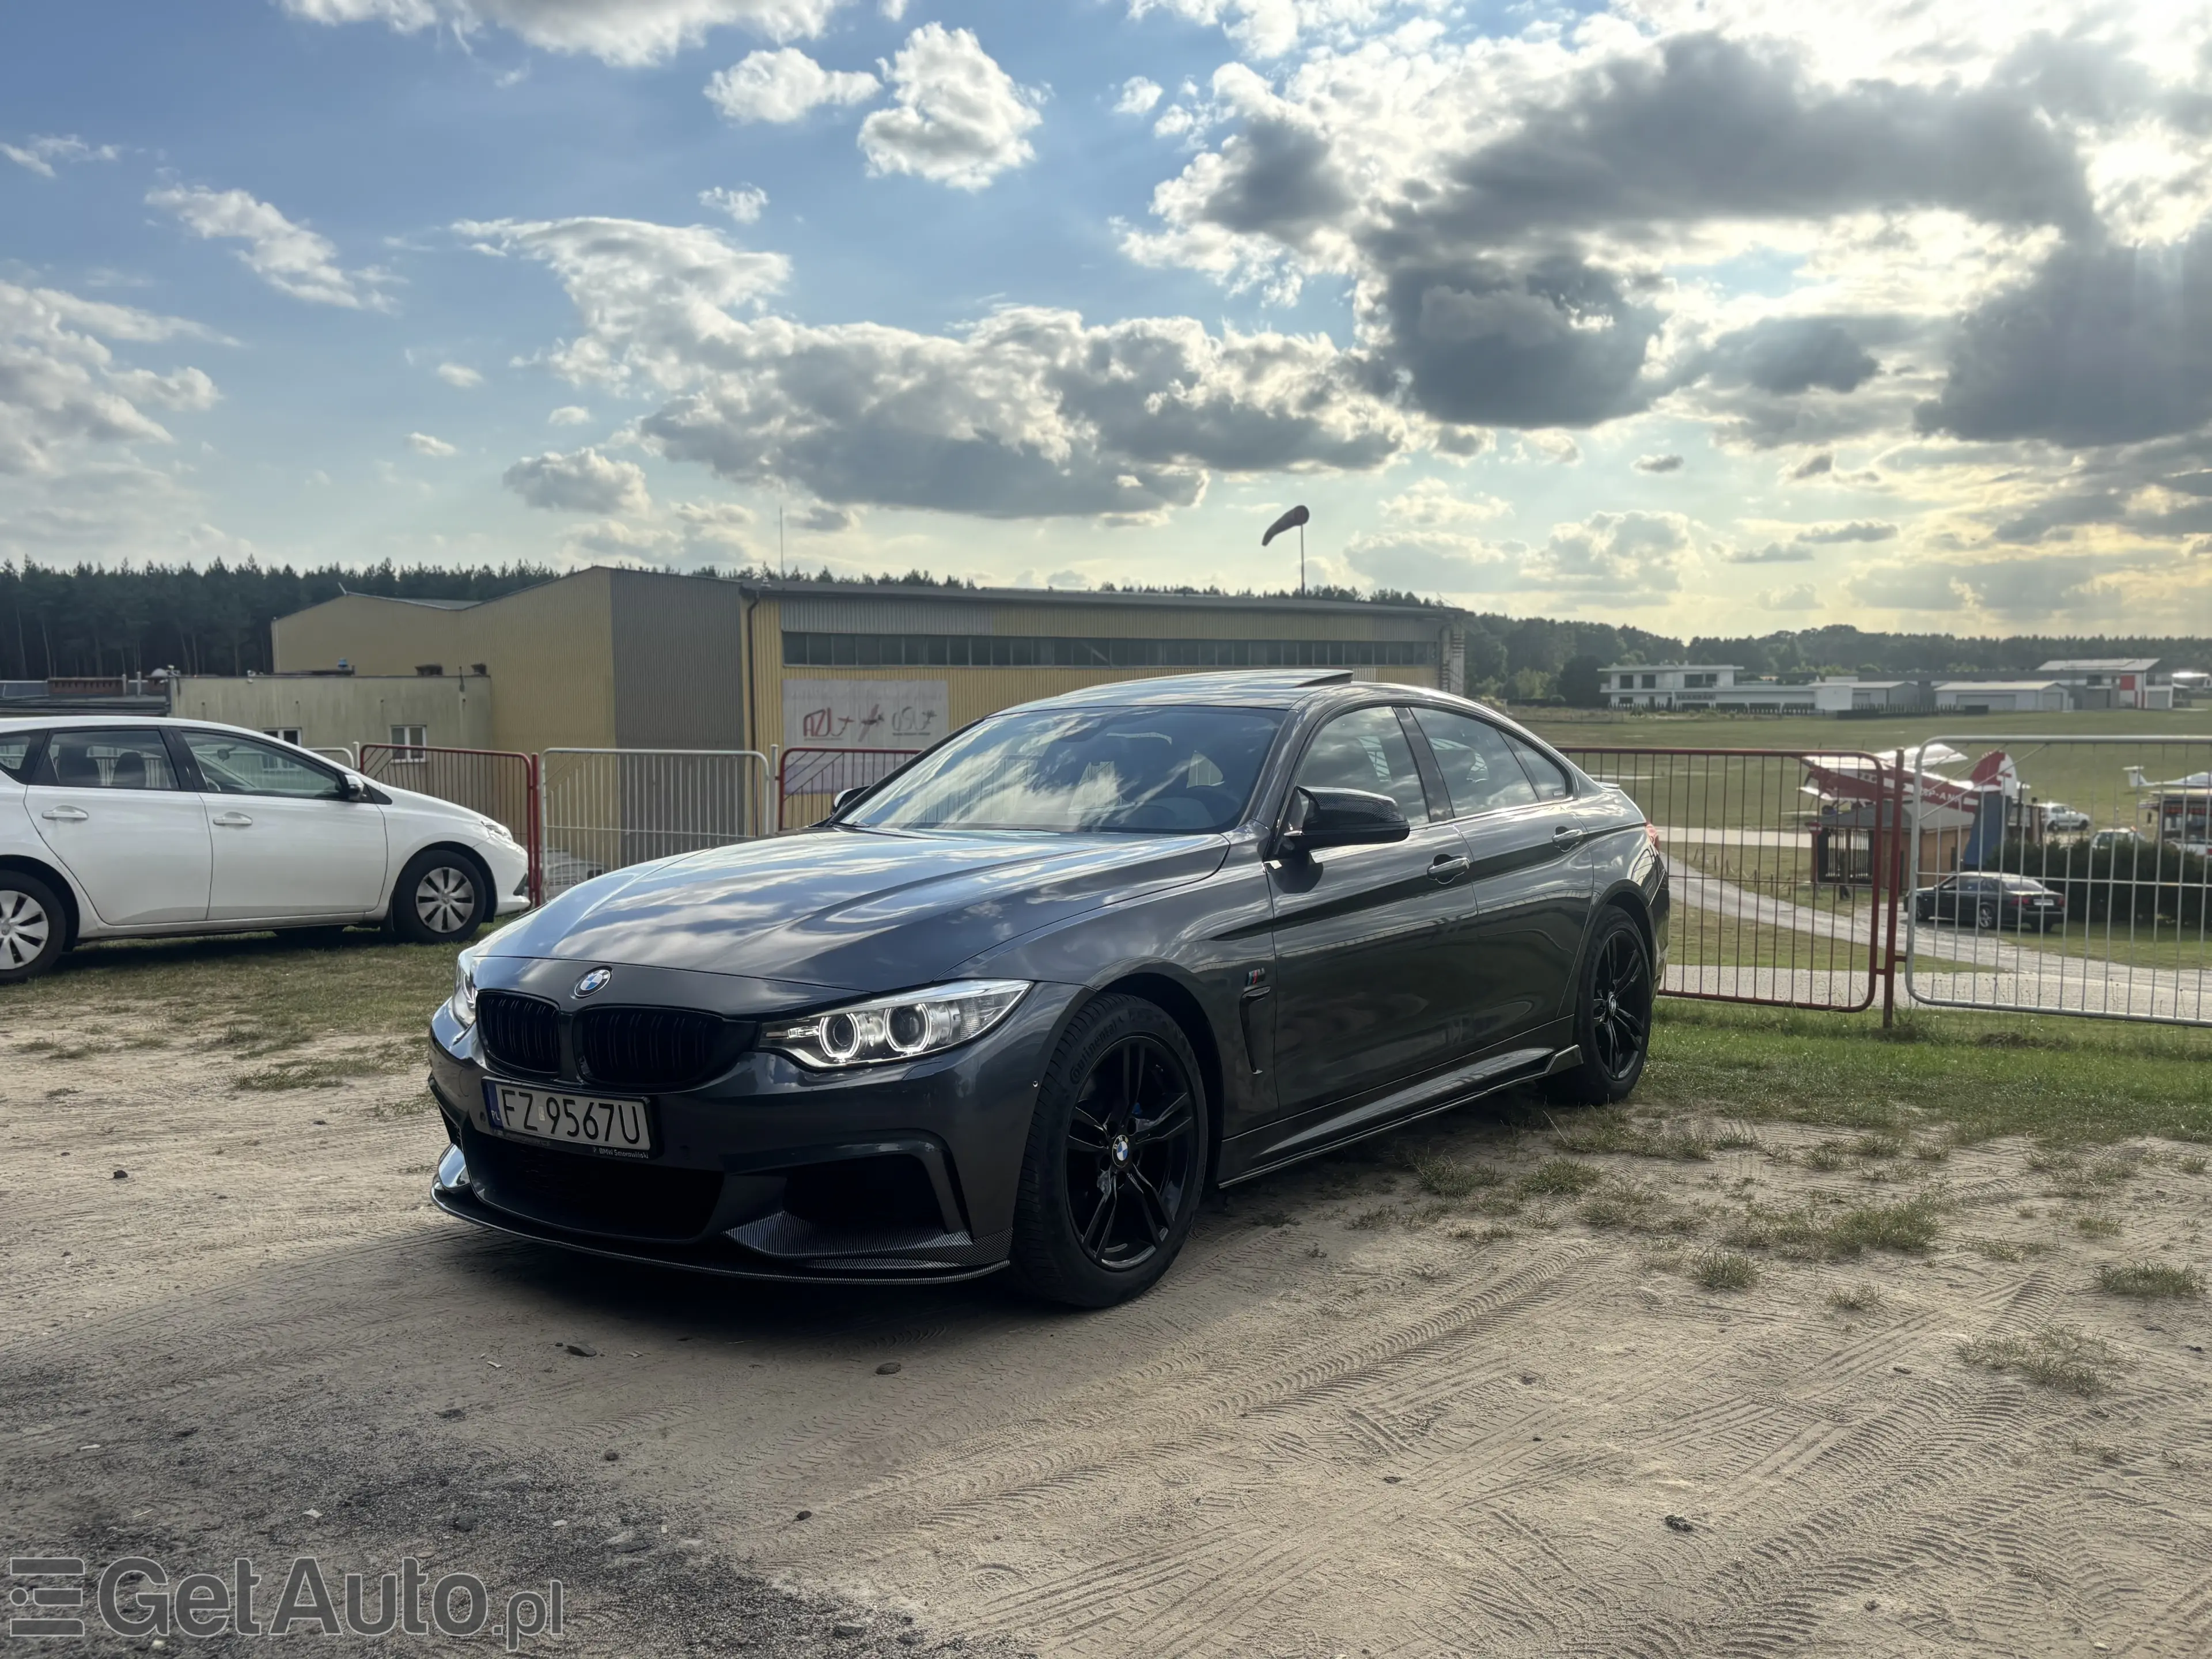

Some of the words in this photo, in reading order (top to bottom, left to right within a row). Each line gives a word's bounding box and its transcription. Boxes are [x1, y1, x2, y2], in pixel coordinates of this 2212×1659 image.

[1069, 1019, 1118, 1085] Continental
[491, 1109, 501, 1120] PL
[501, 1089, 538, 1131] FZ
[546, 1097, 640, 1145] 9567U
[599, 1147, 613, 1156] BMW
